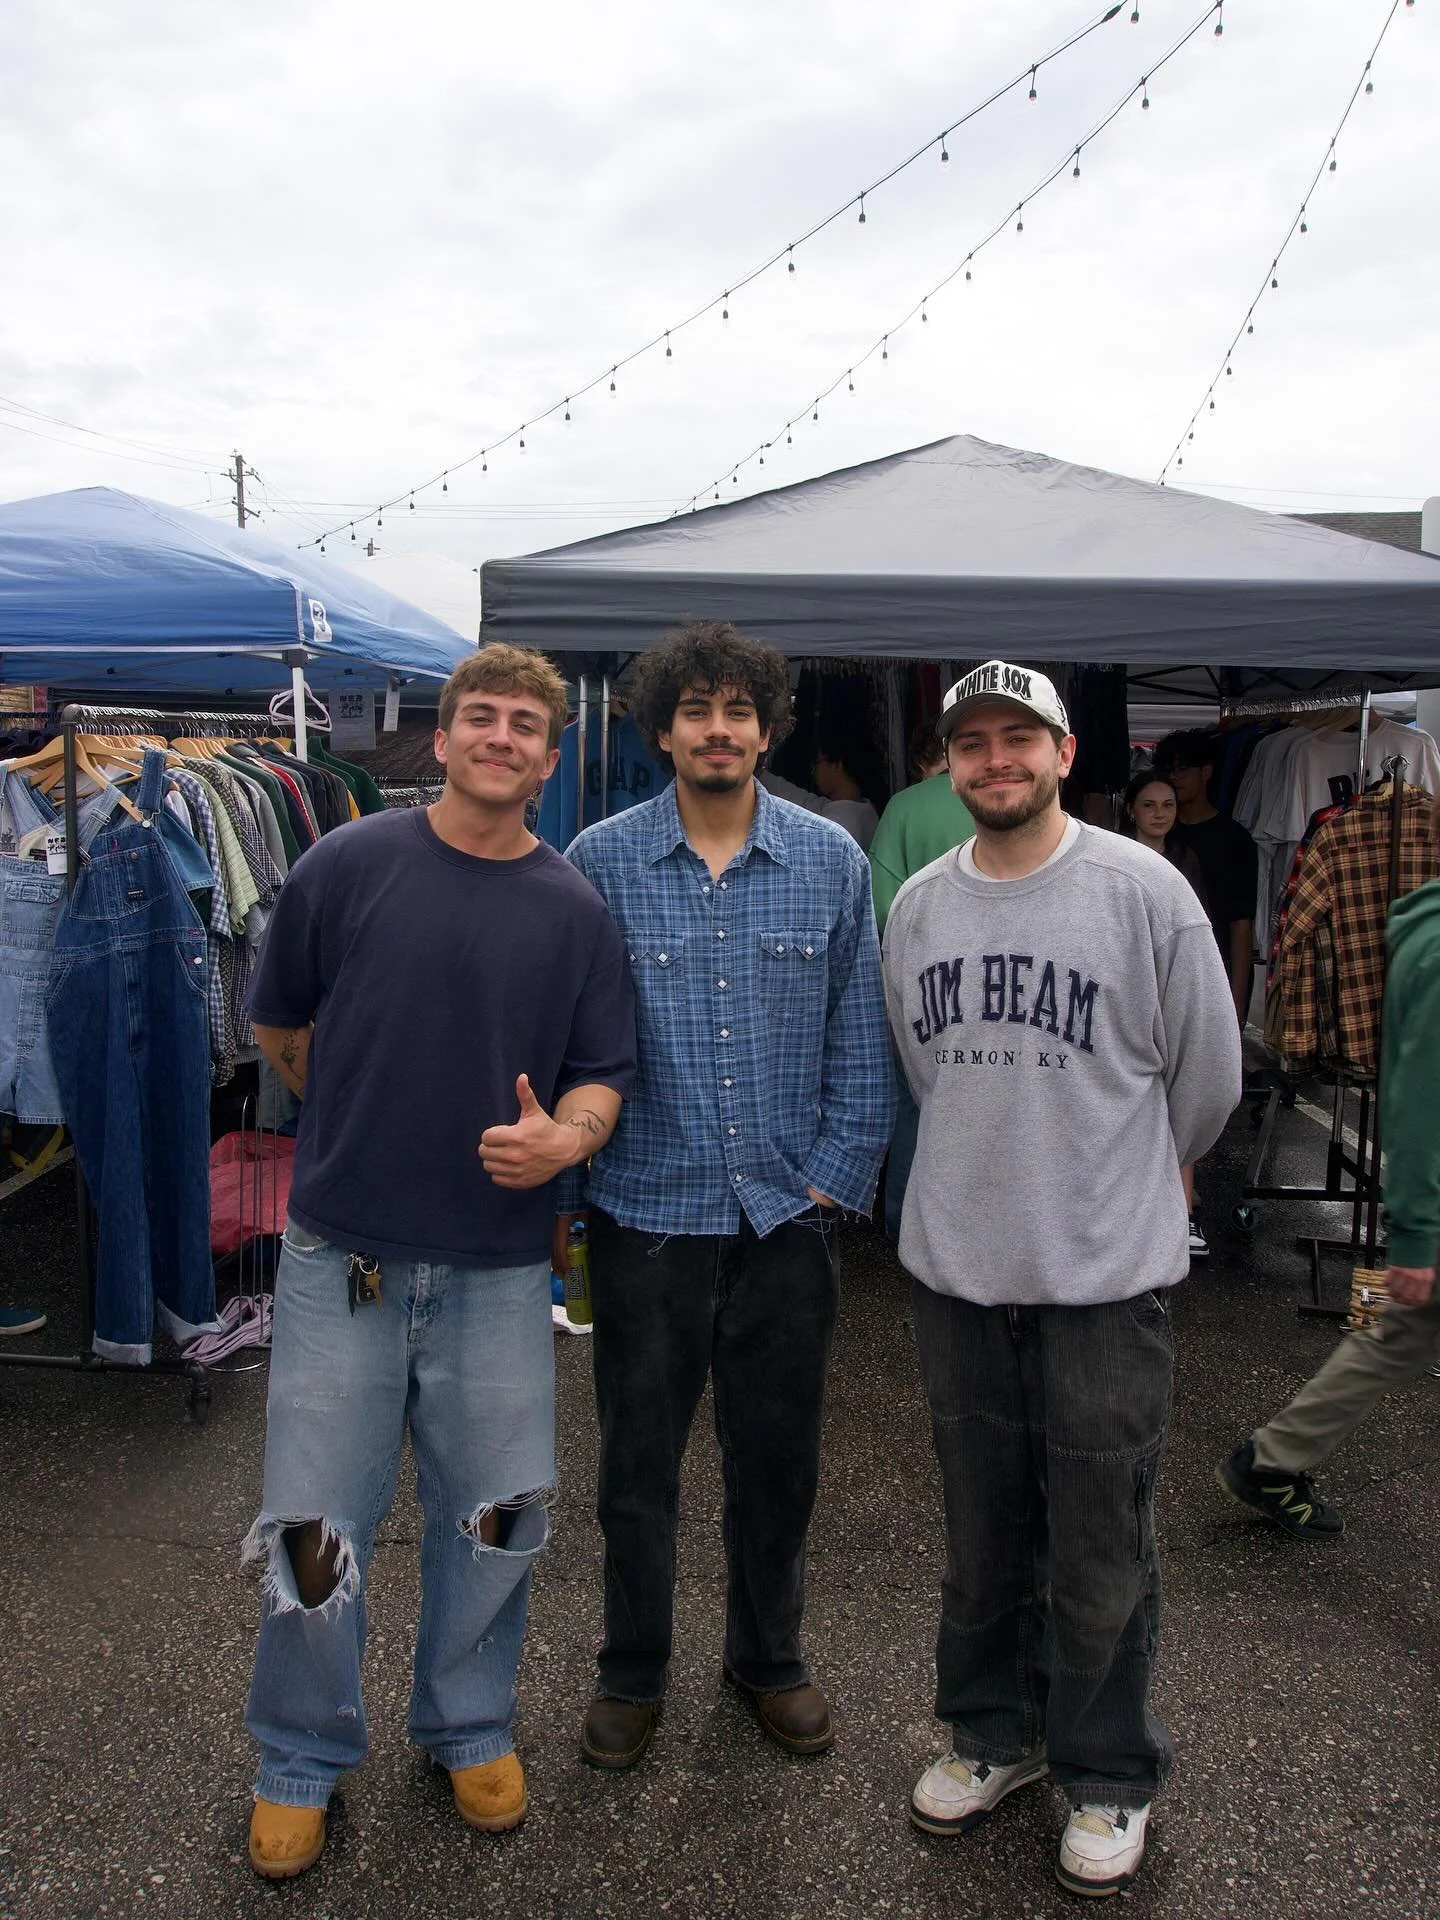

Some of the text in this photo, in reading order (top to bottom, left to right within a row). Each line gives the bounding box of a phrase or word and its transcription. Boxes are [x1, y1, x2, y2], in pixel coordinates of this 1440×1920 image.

[955, 664, 1032, 701] WHITE SOX
[586, 757, 651, 798] GAP
[913, 953, 1100, 1054] JIM BEAM
[1038, 1052, 1068, 1069] KY
